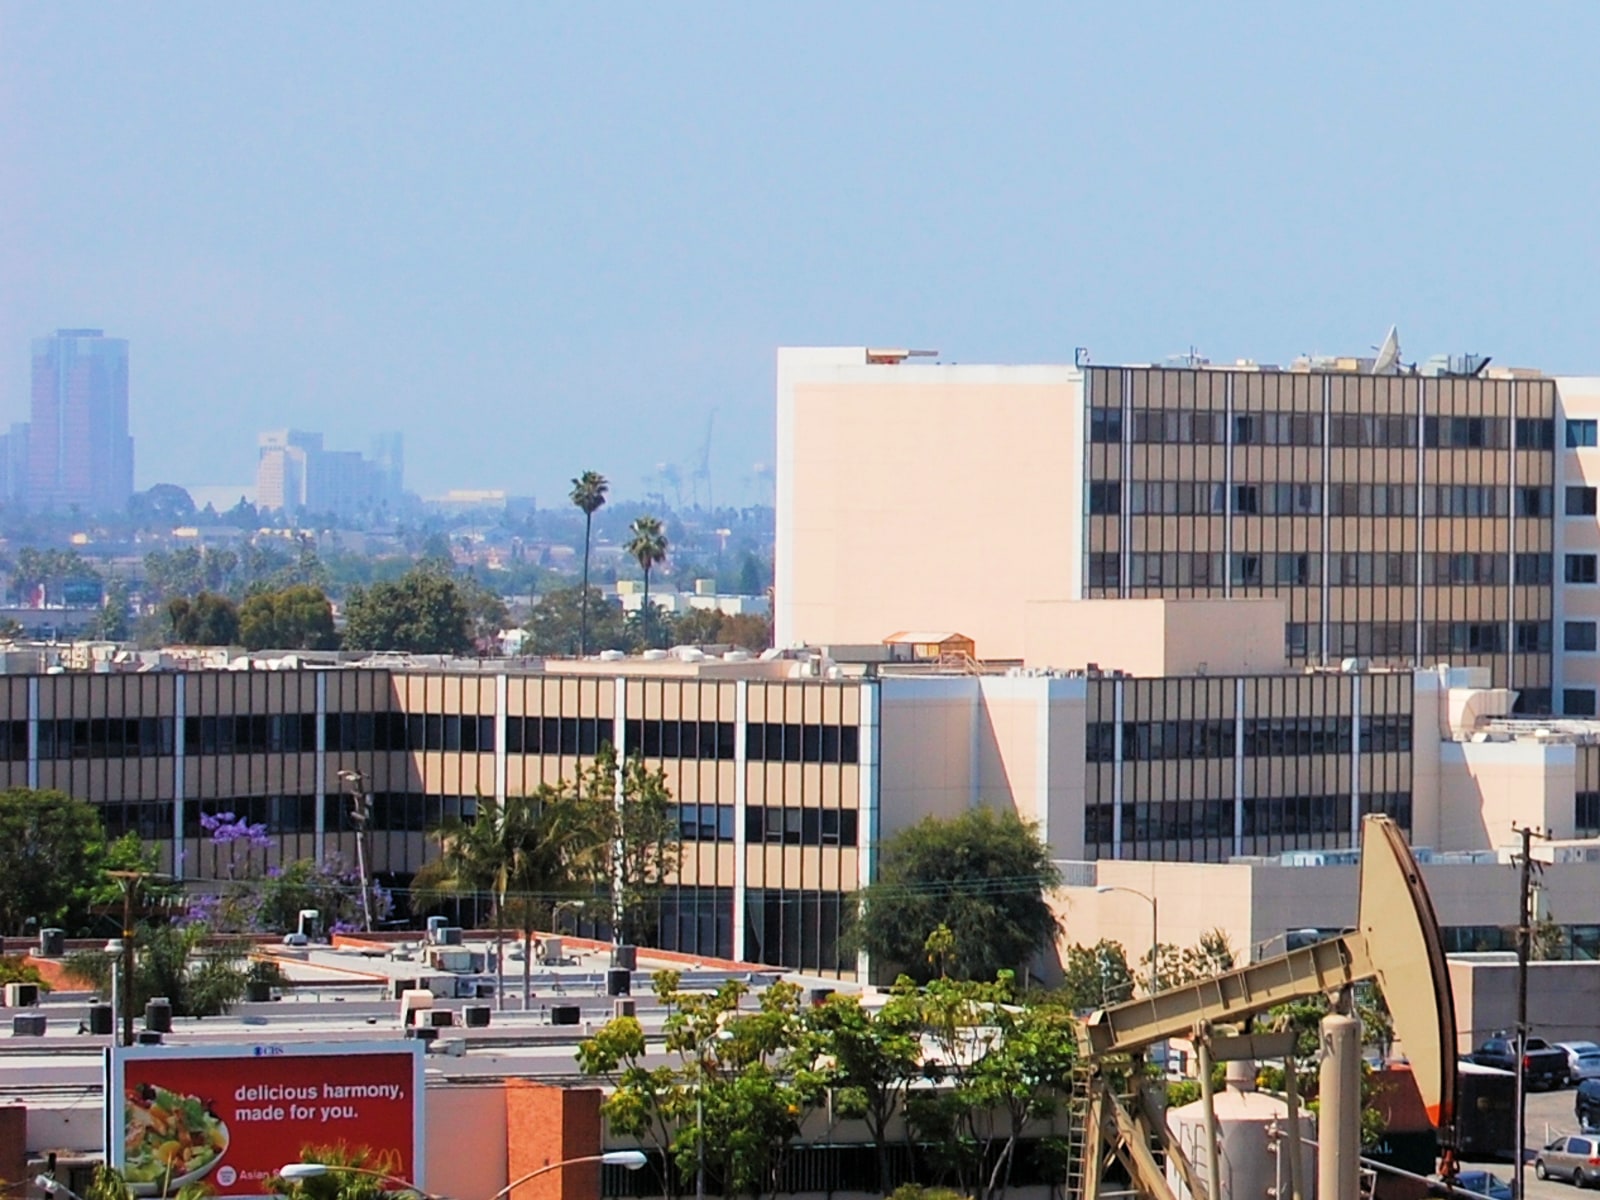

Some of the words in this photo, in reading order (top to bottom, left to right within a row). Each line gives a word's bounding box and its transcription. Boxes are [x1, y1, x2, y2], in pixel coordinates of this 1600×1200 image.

[263, 1046, 284, 1055] CBS
[235, 1084, 318, 1101] delicious
[323, 1083, 404, 1100] harmony,
[235, 1105, 285, 1121] made
[290, 1104, 316, 1120] for
[320, 1105, 358, 1122] you.
[240, 1169, 270, 1179] Asian
